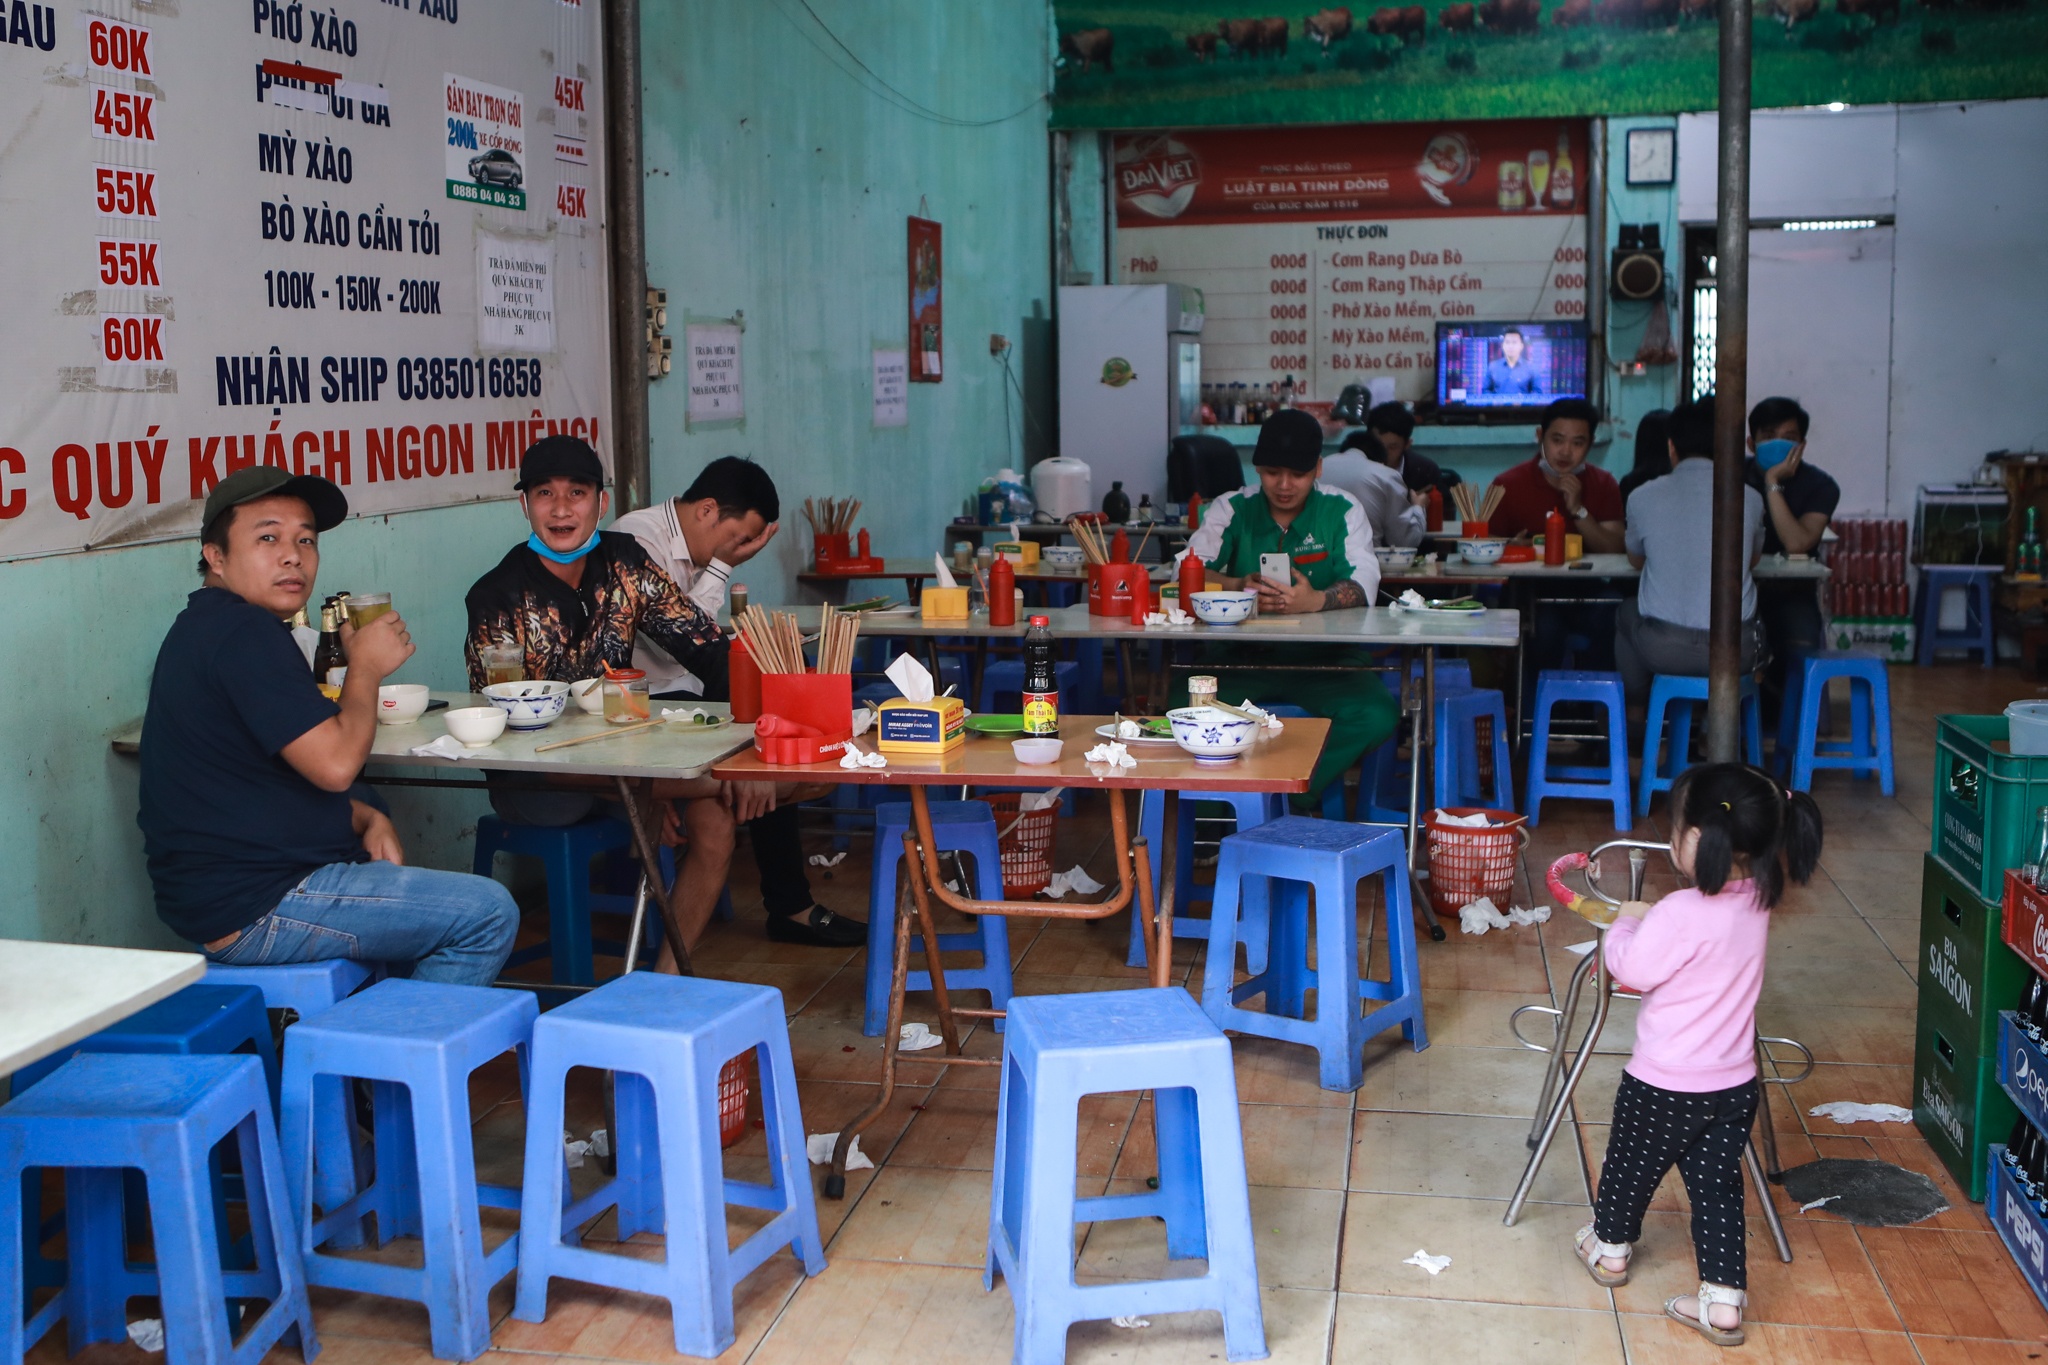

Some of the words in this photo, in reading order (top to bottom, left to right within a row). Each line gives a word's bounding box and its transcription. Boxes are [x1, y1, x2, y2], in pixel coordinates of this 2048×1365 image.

[310, 7, 358, 57] XÀO
[89, 21, 151, 75] 60K
[447, 78, 464, 112] SÂN
[466, 90, 483, 119] BAY
[507, 96, 522, 128] GÓI
[555, 76, 584, 111] 45K
[94, 89, 155, 141] 45K
[479, 132, 488, 146] XE
[258, 129, 297, 176] MỲ
[305, 136, 353, 184] XÀO
[1321, 162, 1352, 171] THEO
[96, 168, 157, 216] 55K
[453, 184, 477, 198] 0886
[480, 189, 492, 201] 04
[494, 192, 506, 204] 04
[508, 194, 520, 206] 33
[1223, 180, 1266, 195] LUẬT
[1269, 182, 1297, 193] BIA
[1301, 181, 1339, 191] TINH
[557, 185, 586, 218] 45K
[1333, 199, 1359, 208] 1516
[261, 194, 295, 242] BÒ
[302, 201, 350, 247] XÀO
[358, 203, 403, 252] CẦN
[408, 209, 440, 255] TỎI
[1317, 225, 1355, 243] THỰC
[1358, 224, 1388, 239] ĐƠN
[99, 241, 160, 286] 55K
[1131, 256, 1158, 273] Phở
[1270, 253, 1307, 269] 000đ
[1332, 251, 1364, 269] Cơm
[1367, 251, 1405, 271] Rang
[1443, 248, 1462, 265] Bò
[264, 270, 316, 309] 100K
[335, 275, 382, 311] 150K
[399, 279, 441, 314] 200K
[1270, 279, 1307, 295] 000đ
[1332, 277, 1364, 294] Cơm
[1367, 277, 1406, 296] Rang
[1409, 275, 1446, 295] Thập
[1270, 304, 1307, 320] 000đ
[1332, 301, 1362, 319] Phở
[1364, 301, 1392, 318] Xào
[1441, 299, 1475, 317] Giòn
[103, 317, 164, 361] 60K
[514, 324, 524, 335] 3K
[1270, 329, 1307, 345] 000đ
[1332, 328, 1354, 347] Mỳ
[1357, 326, 1385, 343] Xào
[1270, 354, 1307, 370] 000đ
[1332, 351, 1351, 369] Bò
[1354, 351, 1382, 369] Xào
[215, 345, 310, 415] NHẬN
[321, 356, 387, 403] SHIP
[397, 357, 542, 401] 0385016858
[52, 424, 169, 520] QUÝ
[366, 423, 474, 483] NGON
[1944, 935, 1958, 966] BIA
[1929, 943, 1971, 1015] SAIGON
[1923, 1076, 1935, 1110] Bia
[1935, 1093, 1964, 1148] SAIGON
[2006, 1189, 2045, 1277] PEPSI
